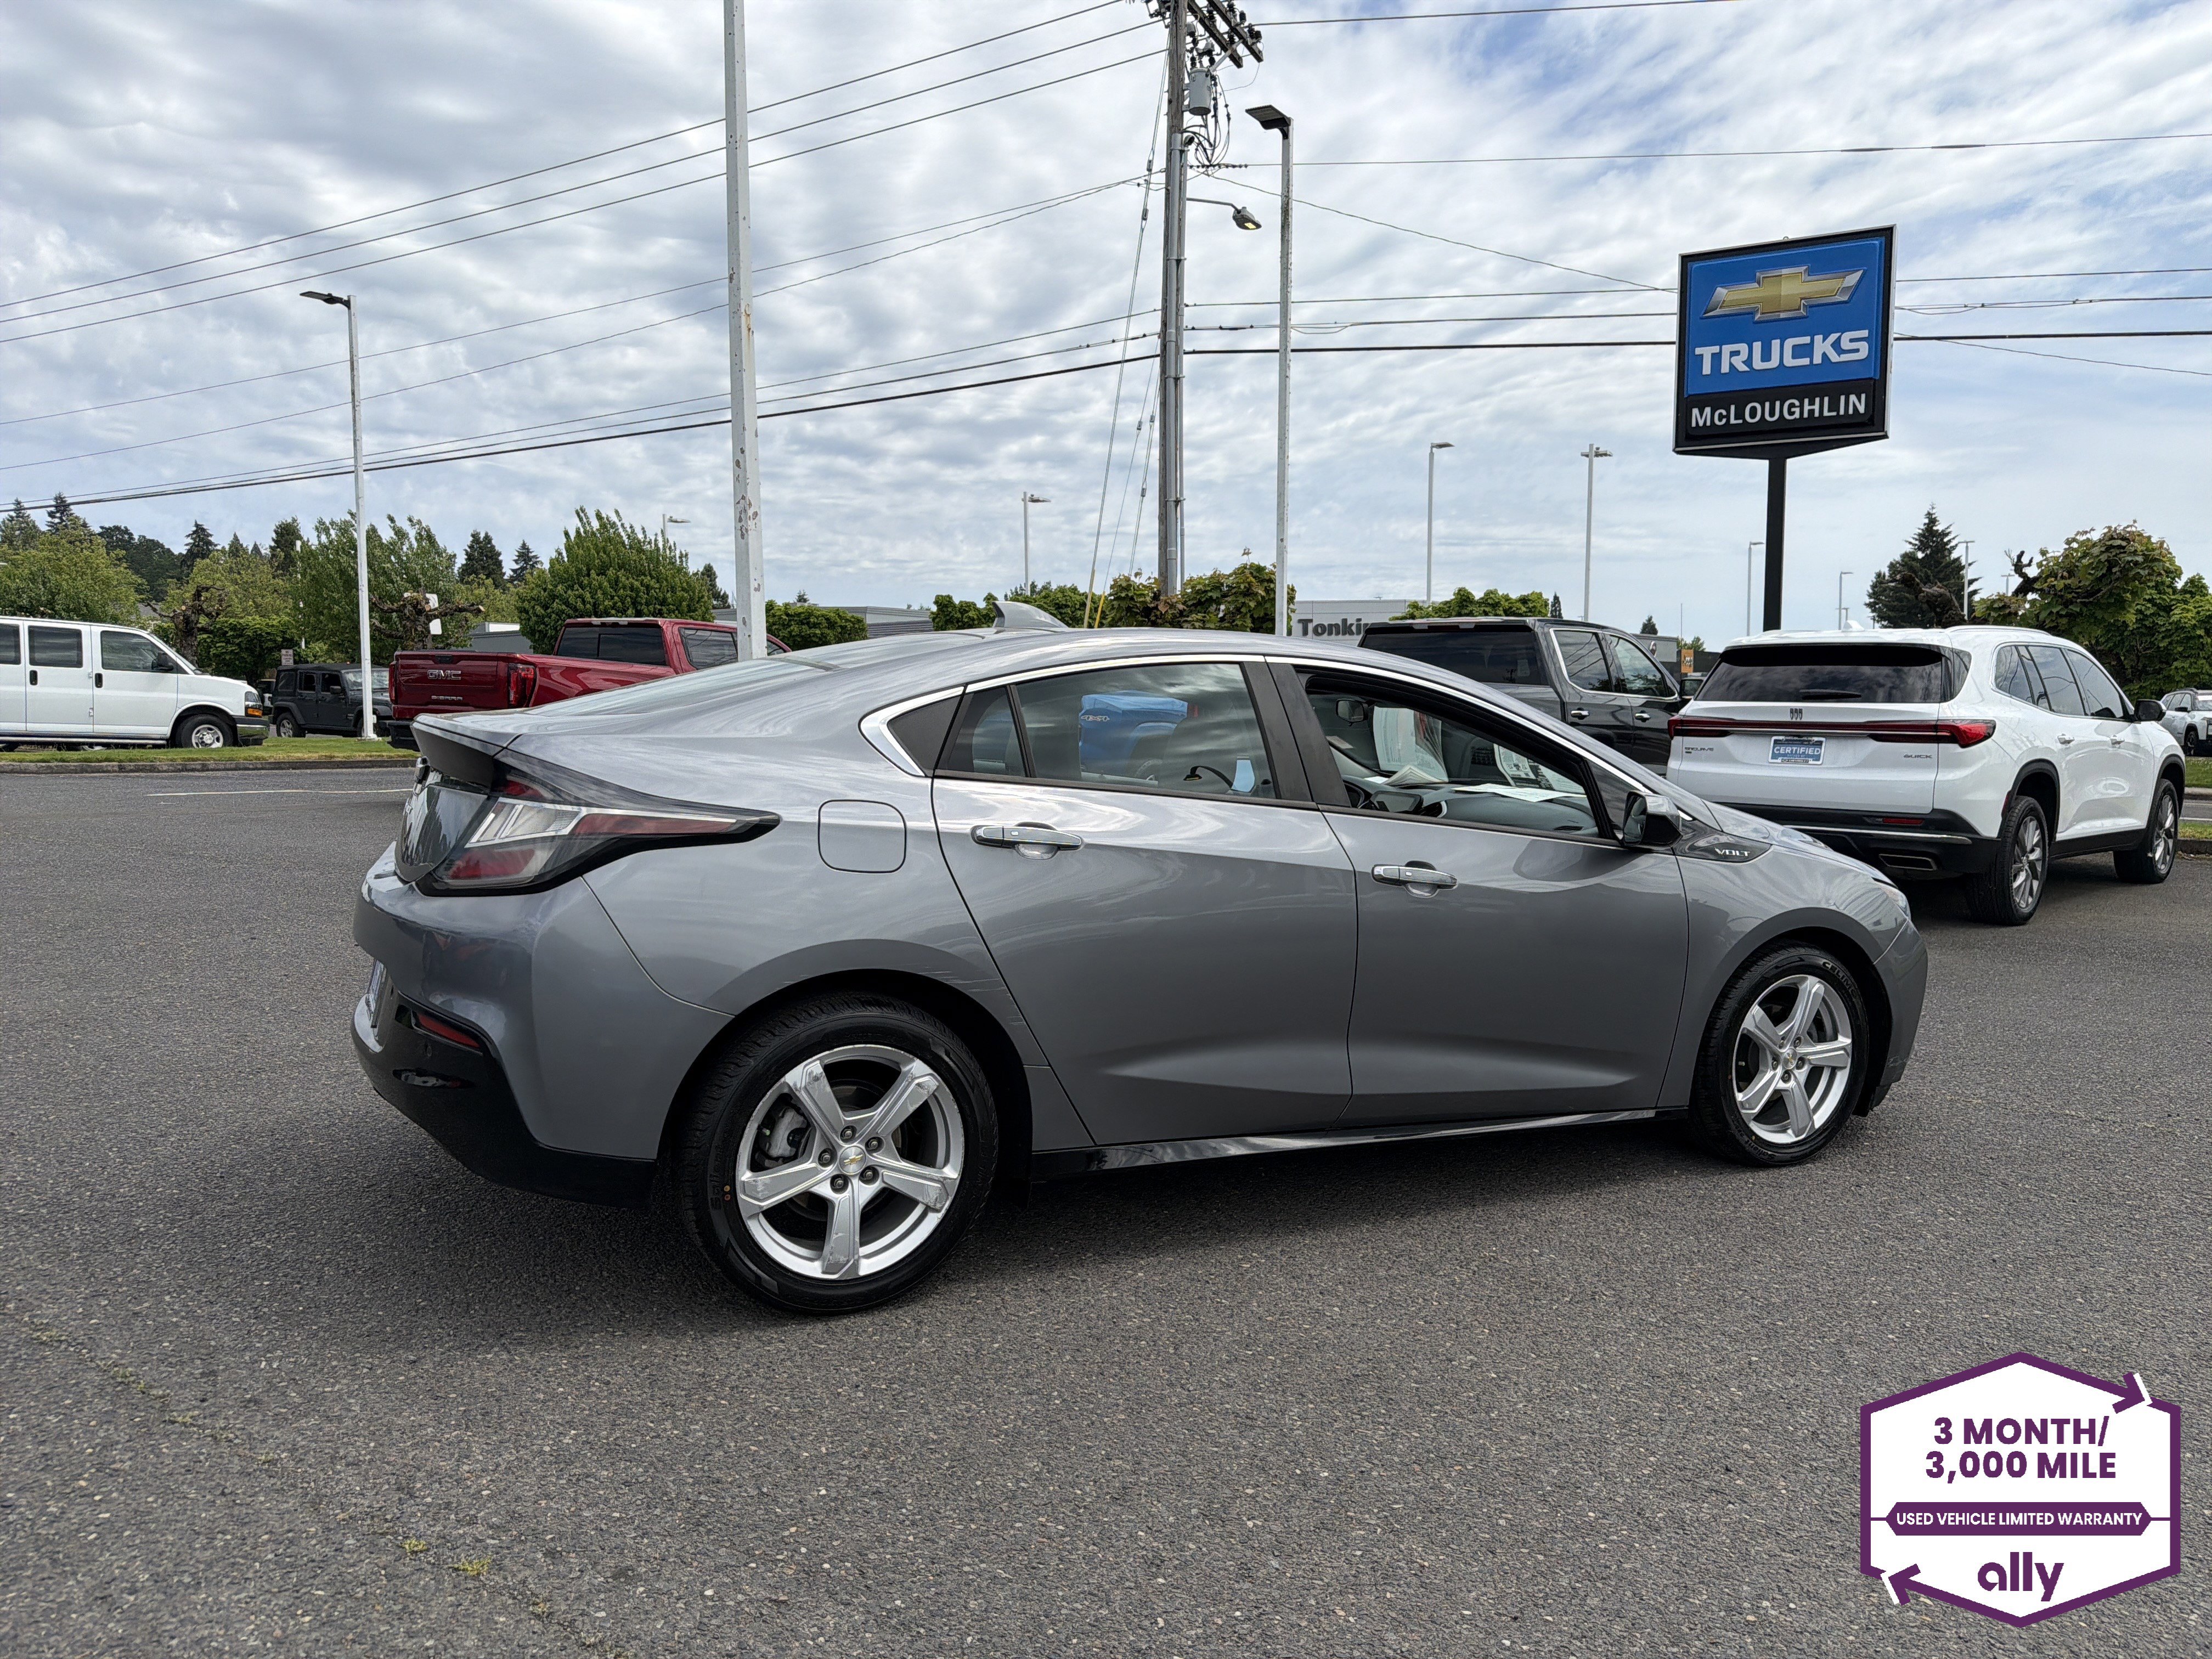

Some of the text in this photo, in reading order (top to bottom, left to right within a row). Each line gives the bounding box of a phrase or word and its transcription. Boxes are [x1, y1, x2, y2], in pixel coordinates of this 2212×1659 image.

[1695, 329, 1869, 375] TRUCKS
[1691, 393, 1866, 428] McLOUGHLIN
[427, 669, 461, 680] GMC
[1774, 747, 1821, 755] CERTIFIED
[1714, 847, 1751, 857] VOLT
